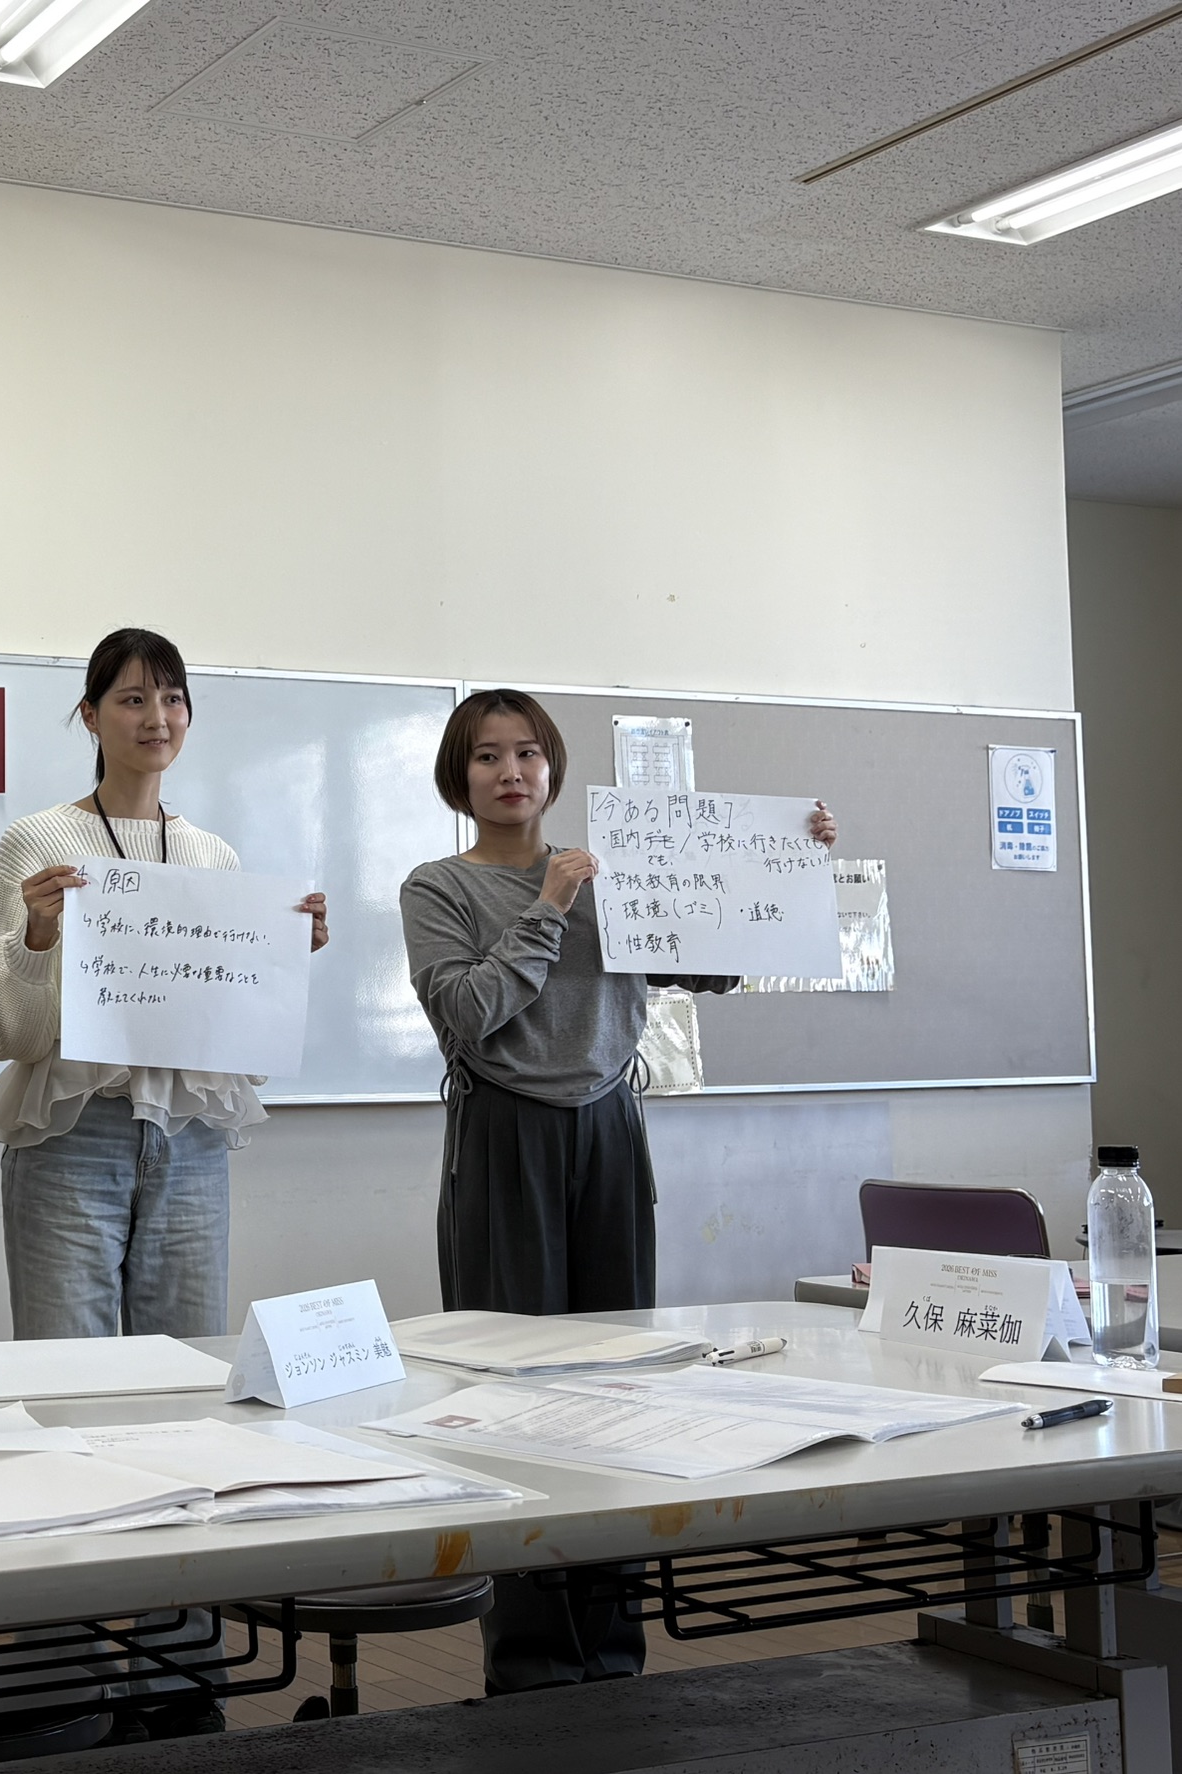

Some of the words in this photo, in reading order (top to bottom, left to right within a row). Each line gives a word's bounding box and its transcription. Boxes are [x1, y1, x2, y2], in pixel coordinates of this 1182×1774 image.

[102, 868, 140, 895] 原因
[955, 1266, 970, 1274] BEST
[982, 1269, 997, 1278] MISS
[903, 1300, 944, 1333] 久保
[953, 1308, 1022, 1345] 麻菜伽
[285, 1358, 325, 1378] ジョンソン
[330, 1348, 369, 1368] ジャスミン
